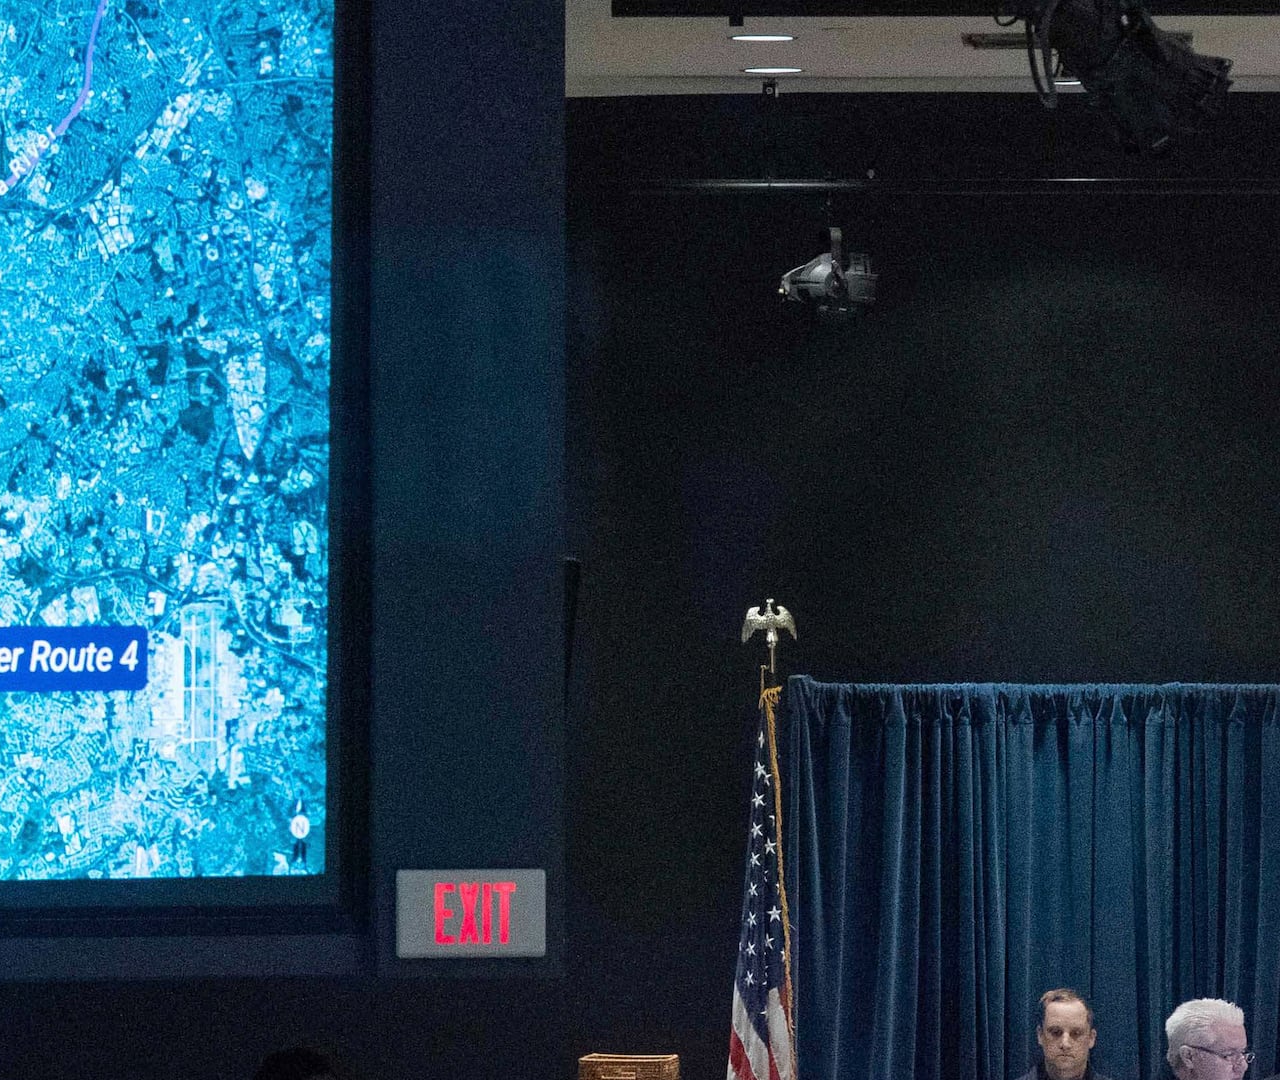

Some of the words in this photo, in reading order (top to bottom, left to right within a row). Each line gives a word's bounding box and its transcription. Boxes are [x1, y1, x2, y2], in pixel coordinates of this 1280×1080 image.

[9, 124, 56, 179] River
[29, 640, 113, 673] Route
[119, 639, 139, 671] 4
[434, 881, 517, 945] EXIT
